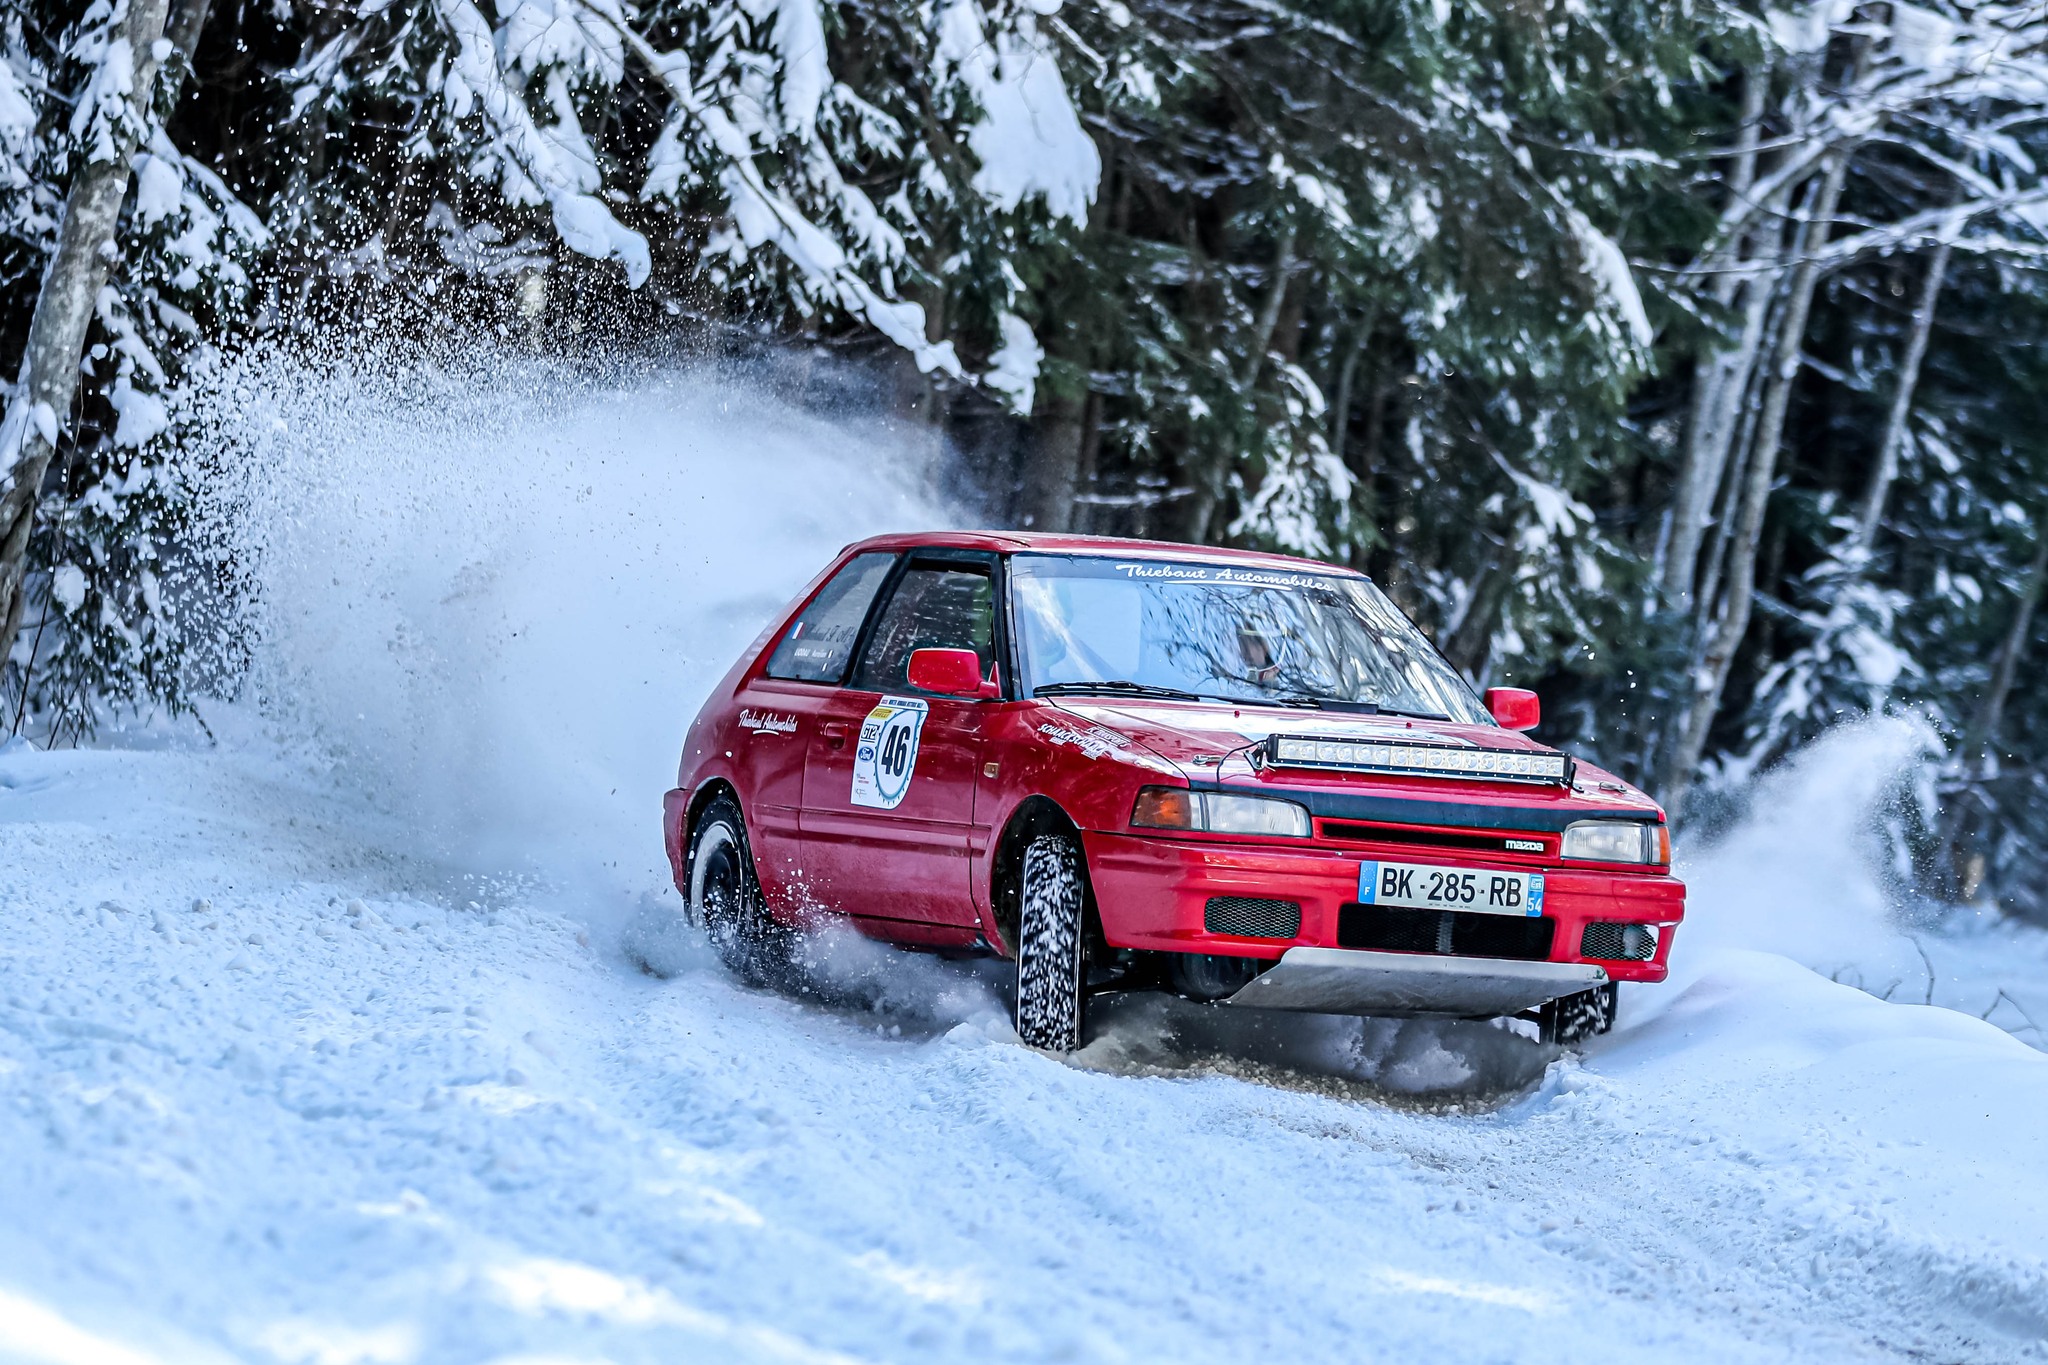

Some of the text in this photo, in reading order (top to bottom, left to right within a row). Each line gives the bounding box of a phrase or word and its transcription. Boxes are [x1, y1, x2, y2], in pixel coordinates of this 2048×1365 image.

[1115, 564, 1335, 592] Thiebaut Automobiles
[881, 725, 911, 777] 46
[1364, 886, 1371, 896] F
[1527, 897, 1542, 912] 54
